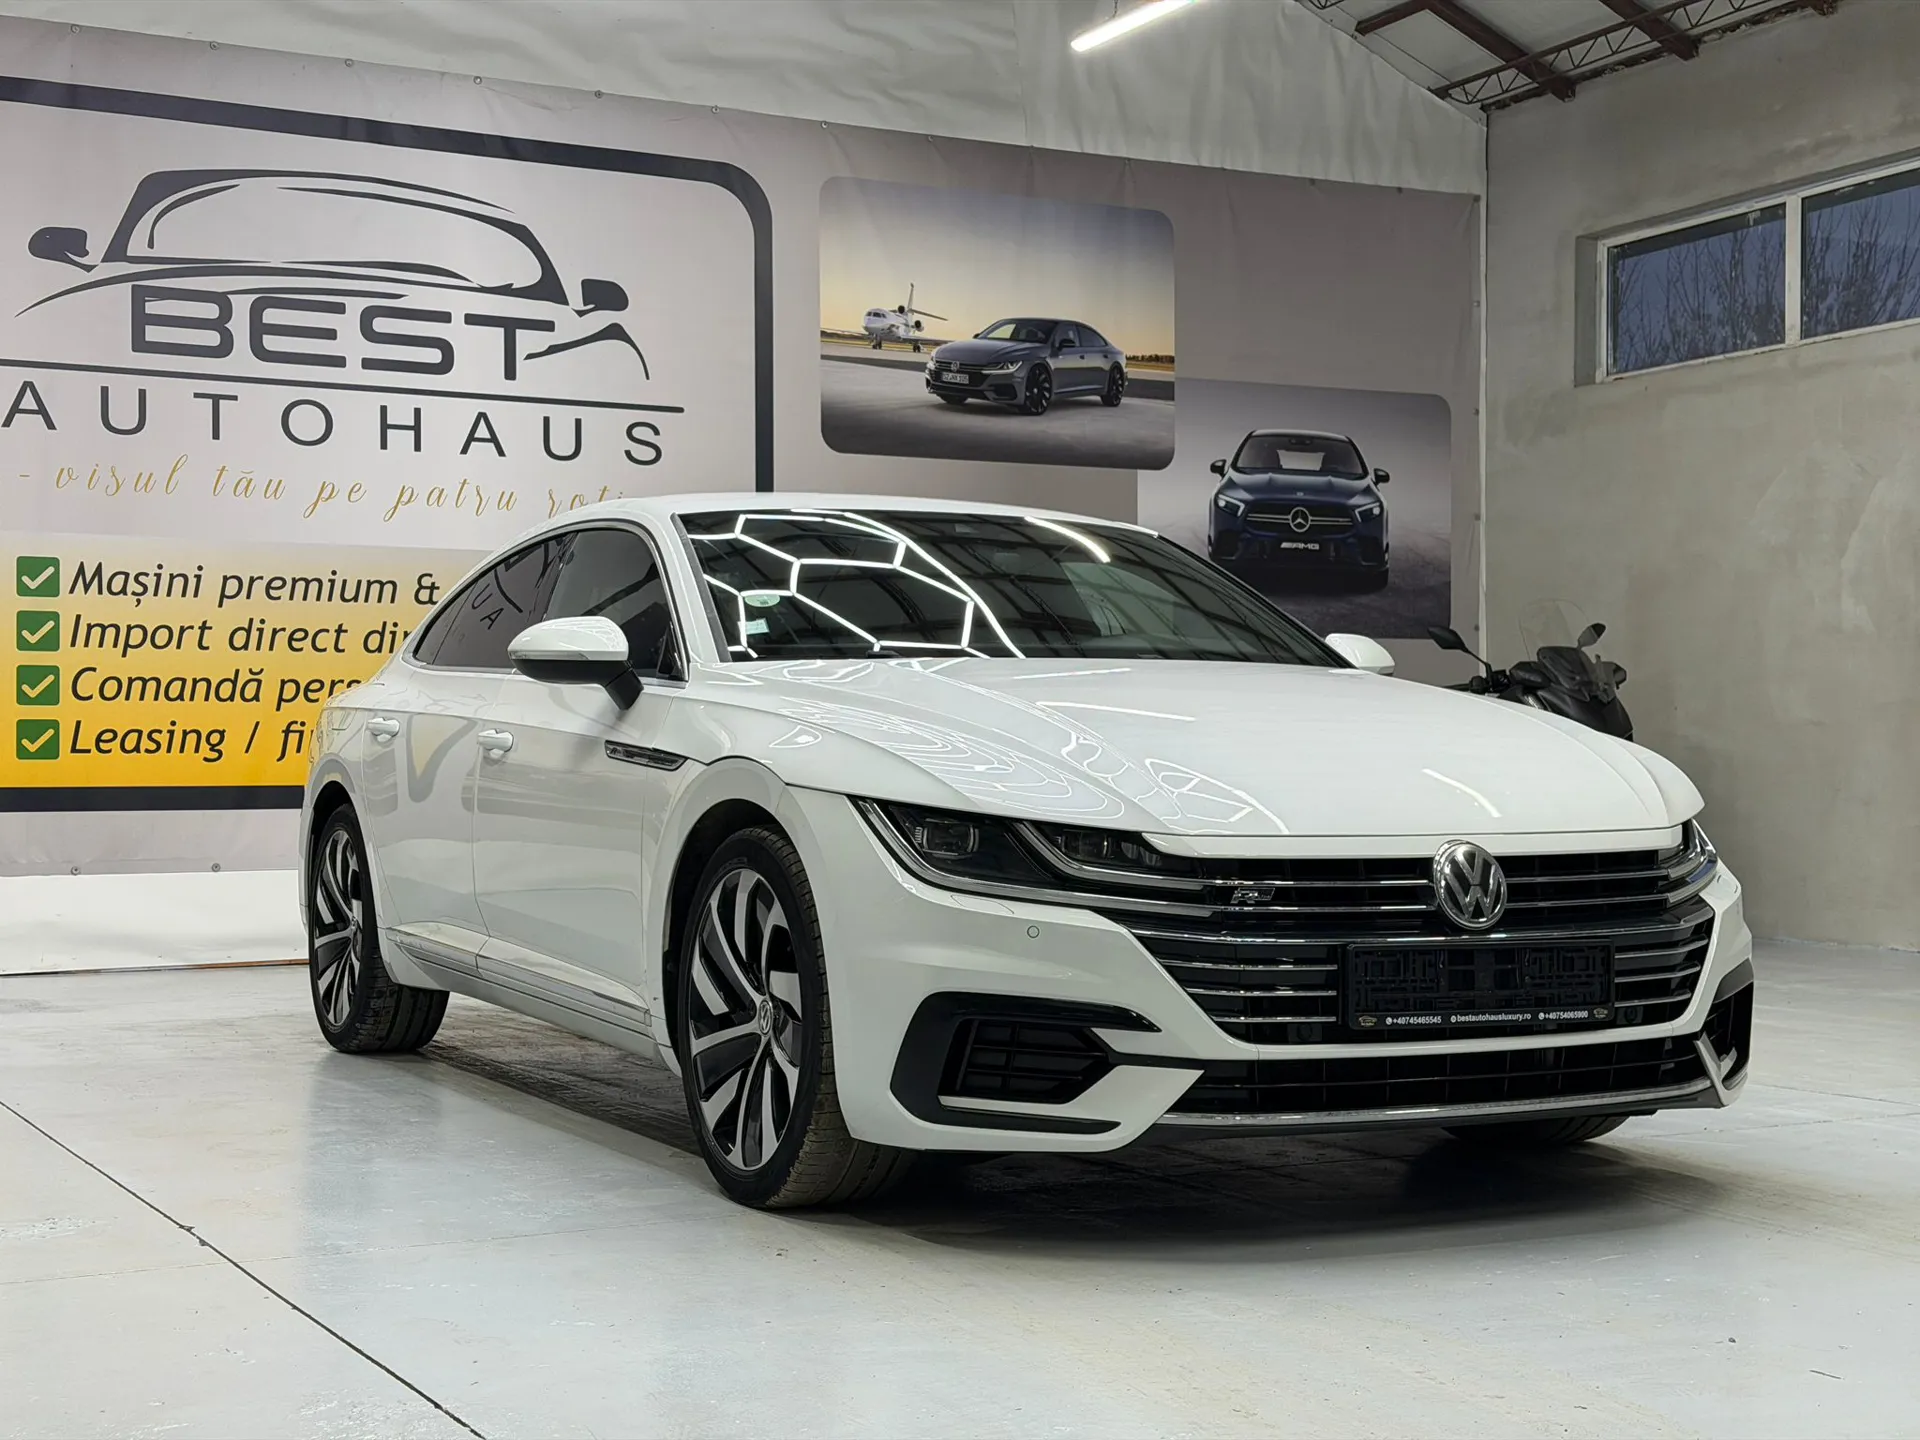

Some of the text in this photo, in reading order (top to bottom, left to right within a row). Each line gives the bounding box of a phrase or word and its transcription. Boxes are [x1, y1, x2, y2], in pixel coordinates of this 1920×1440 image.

[131, 284, 556, 381] BEST
[1, 380, 663, 466] AUTOHAUS
[56, 454, 188, 497] visul
[213, 465, 286, 500] tău
[303, 480, 367, 519] pe
[383, 478, 517, 523] patru
[68, 561, 440, 608] Mașini premium &
[69, 614, 213, 658] Import
[228, 617, 349, 653] direct
[70, 667, 264, 704] Comandă
[69, 720, 227, 763] Leasing
[276, 720, 315, 763] fi
[1457, 1013, 1532, 1022] bestautohausluxury.ro
